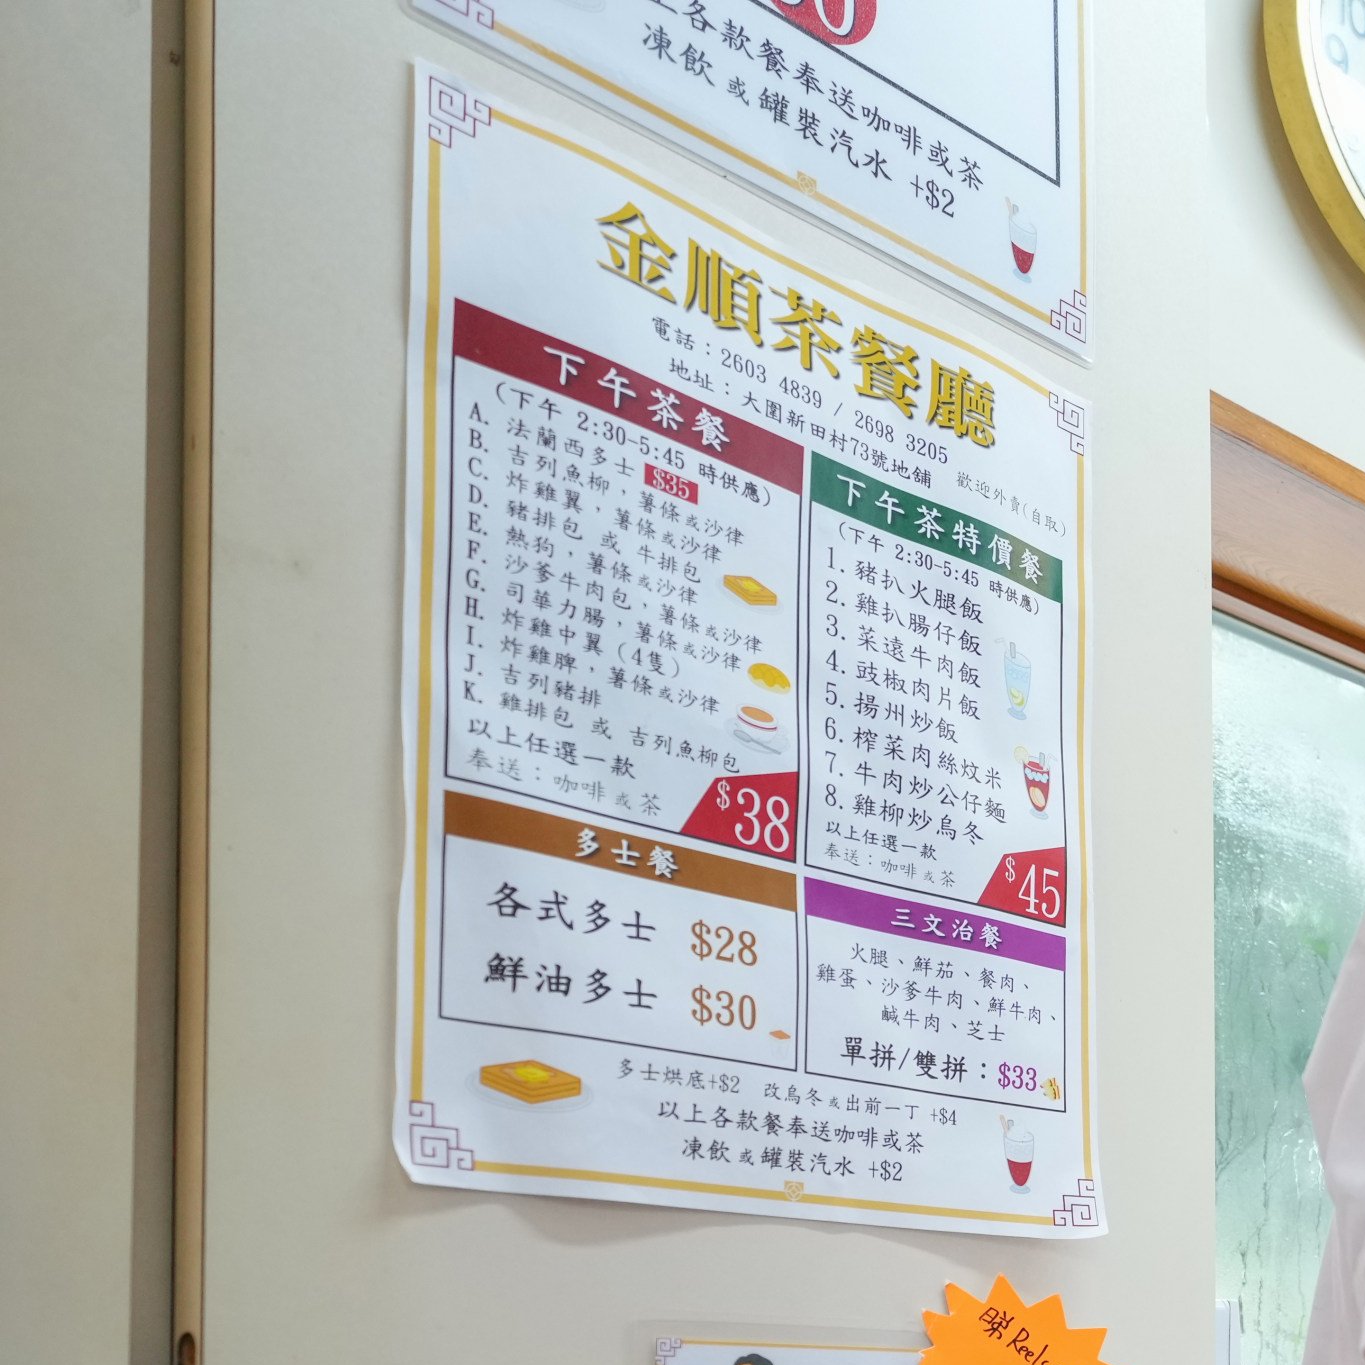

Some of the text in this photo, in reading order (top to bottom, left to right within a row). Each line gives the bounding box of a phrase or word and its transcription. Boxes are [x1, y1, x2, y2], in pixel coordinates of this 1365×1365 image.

[650, 0, 984, 190] 各款餐奉送咖啡或茶
[911, 175, 957, 218] +$2
[596, 201, 996, 449] 金順茶餐廳
[542, 346, 731, 452] 下午茶餐
[721, 348, 767, 383] 2603
[779, 378, 823, 409] 4839
[855, 411, 894, 444] 2698
[906, 434, 948, 464] 3205
[469, 429, 488, 453] B.
[469, 402, 690, 500] A. 法蘭西多士 $35
[577, 412, 685, 471] 2:30-5:45
[468, 458, 488, 481] C.
[468, 484, 488, 508] D.
[468, 511, 488, 536] E.
[837, 474, 1044, 585] 下午茶特價餐
[466, 540, 487, 564] F.
[895, 544, 979, 588] 2:30-5:45
[465, 569, 486, 593] G.
[826, 546, 985, 625] 1. 豬扒火腿飯
[464, 597, 484, 620] H.
[826, 581, 982, 656] 2. 雞扒腸仔飯
[466, 625, 483, 649] I.
[826, 614, 982, 689] 3. 菜遠牛肉飯
[463, 653, 483, 677] J.
[826, 649, 846, 675] 4.
[463, 680, 484, 704] K.
[825, 681, 959, 744] 5. 揚州炒飯
[468, 718, 637, 780] 以上任選一款
[825, 716, 844, 743] 6.
[825, 750, 844, 778] 7.
[716, 779, 791, 853] $38
[825, 784, 844, 810] 8.
[575, 828, 679, 879] 多士餐
[825, 821, 938, 862] 以上任選一款
[1004, 855, 1061, 919] $45
[487, 882, 758, 967] 各式多士 $28
[890, 908, 1003, 950] 三文治餐
[484, 952, 758, 1031] 鮮油多士 $30
[998, 1061, 1037, 1092] $33
[930, 1107, 958, 1127] +$4
[868, 1159, 903, 1183] +$2
